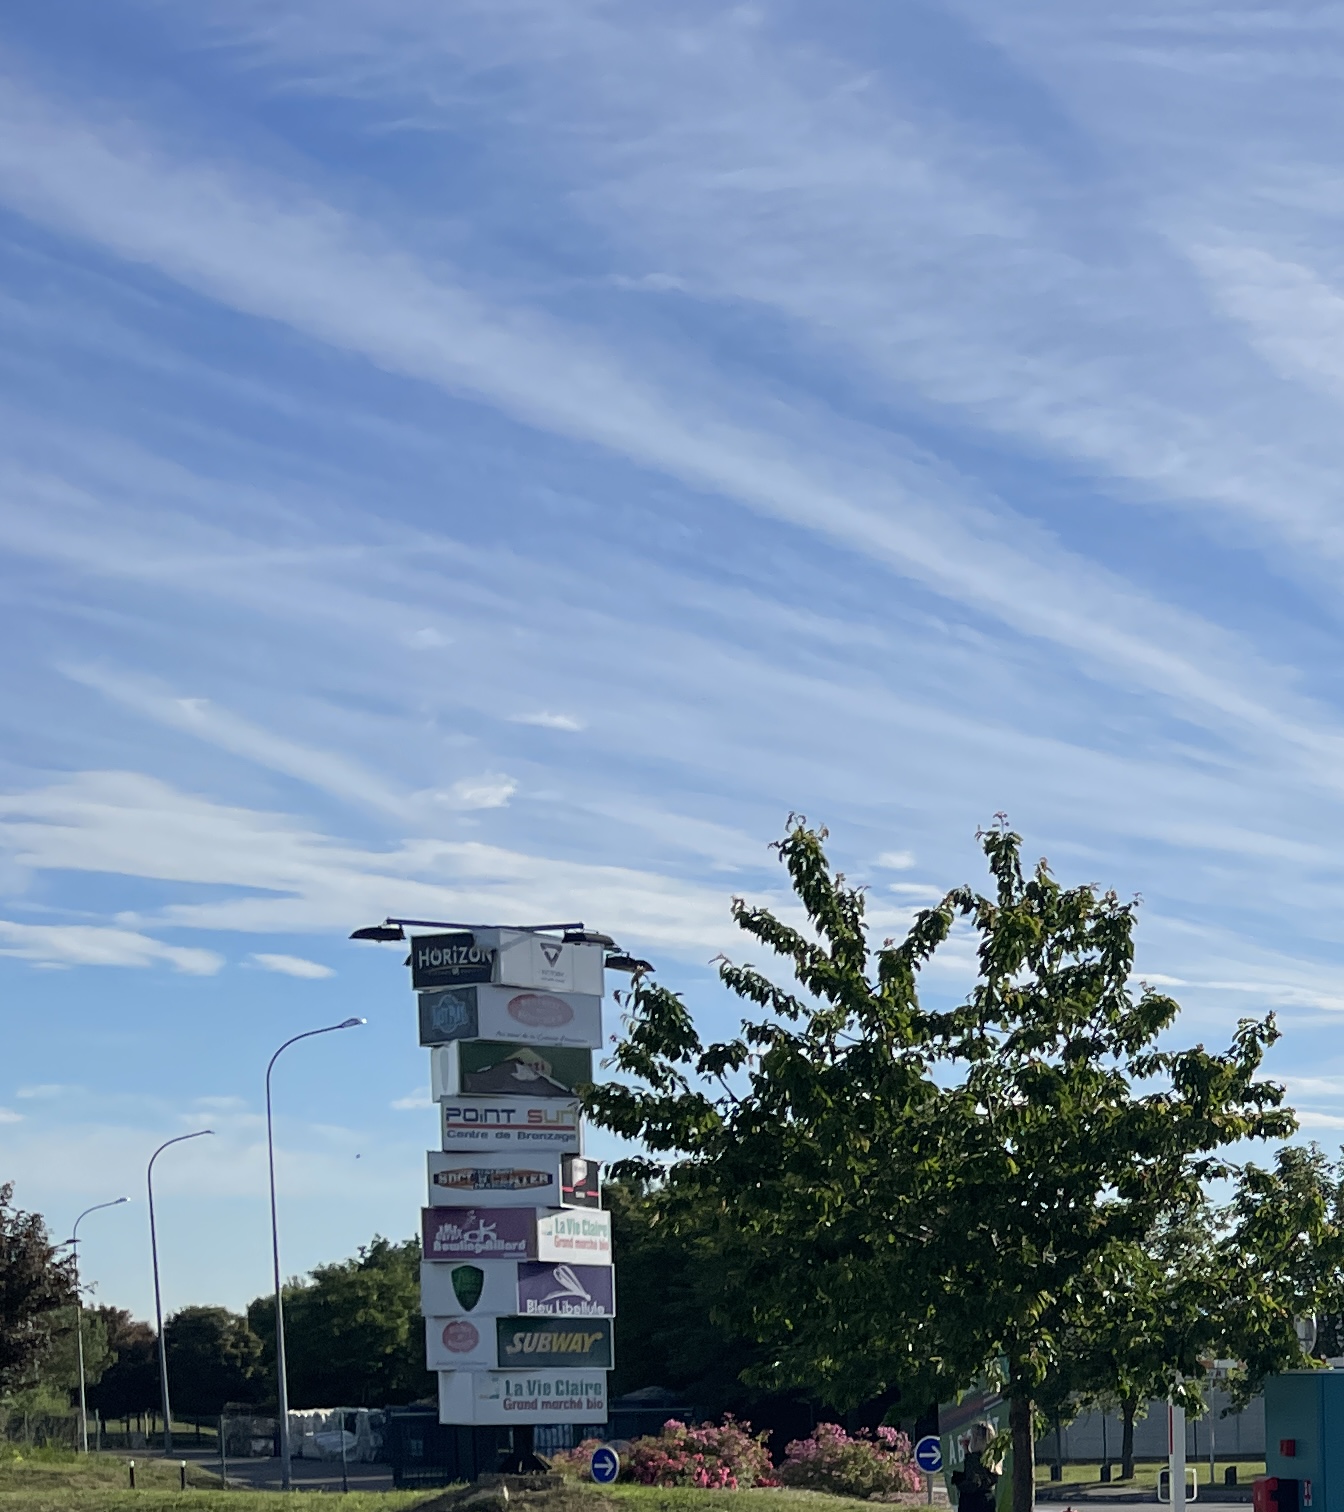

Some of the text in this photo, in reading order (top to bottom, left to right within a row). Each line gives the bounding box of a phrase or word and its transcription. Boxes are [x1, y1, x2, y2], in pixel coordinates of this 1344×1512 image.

[446, 1129, 577, 1142] Centre de Bronzage
[554, 1216, 608, 1237] La Vie Claire
[554, 1235, 574, 1248] Grand
[526, 1299, 605, 1315] Bleu Libellule
[506, 1331, 604, 1354] SUBWAY
[505, 1379, 602, 1397] La Vie Claire
[503, 1398, 604, 1411] Grand marché bio
